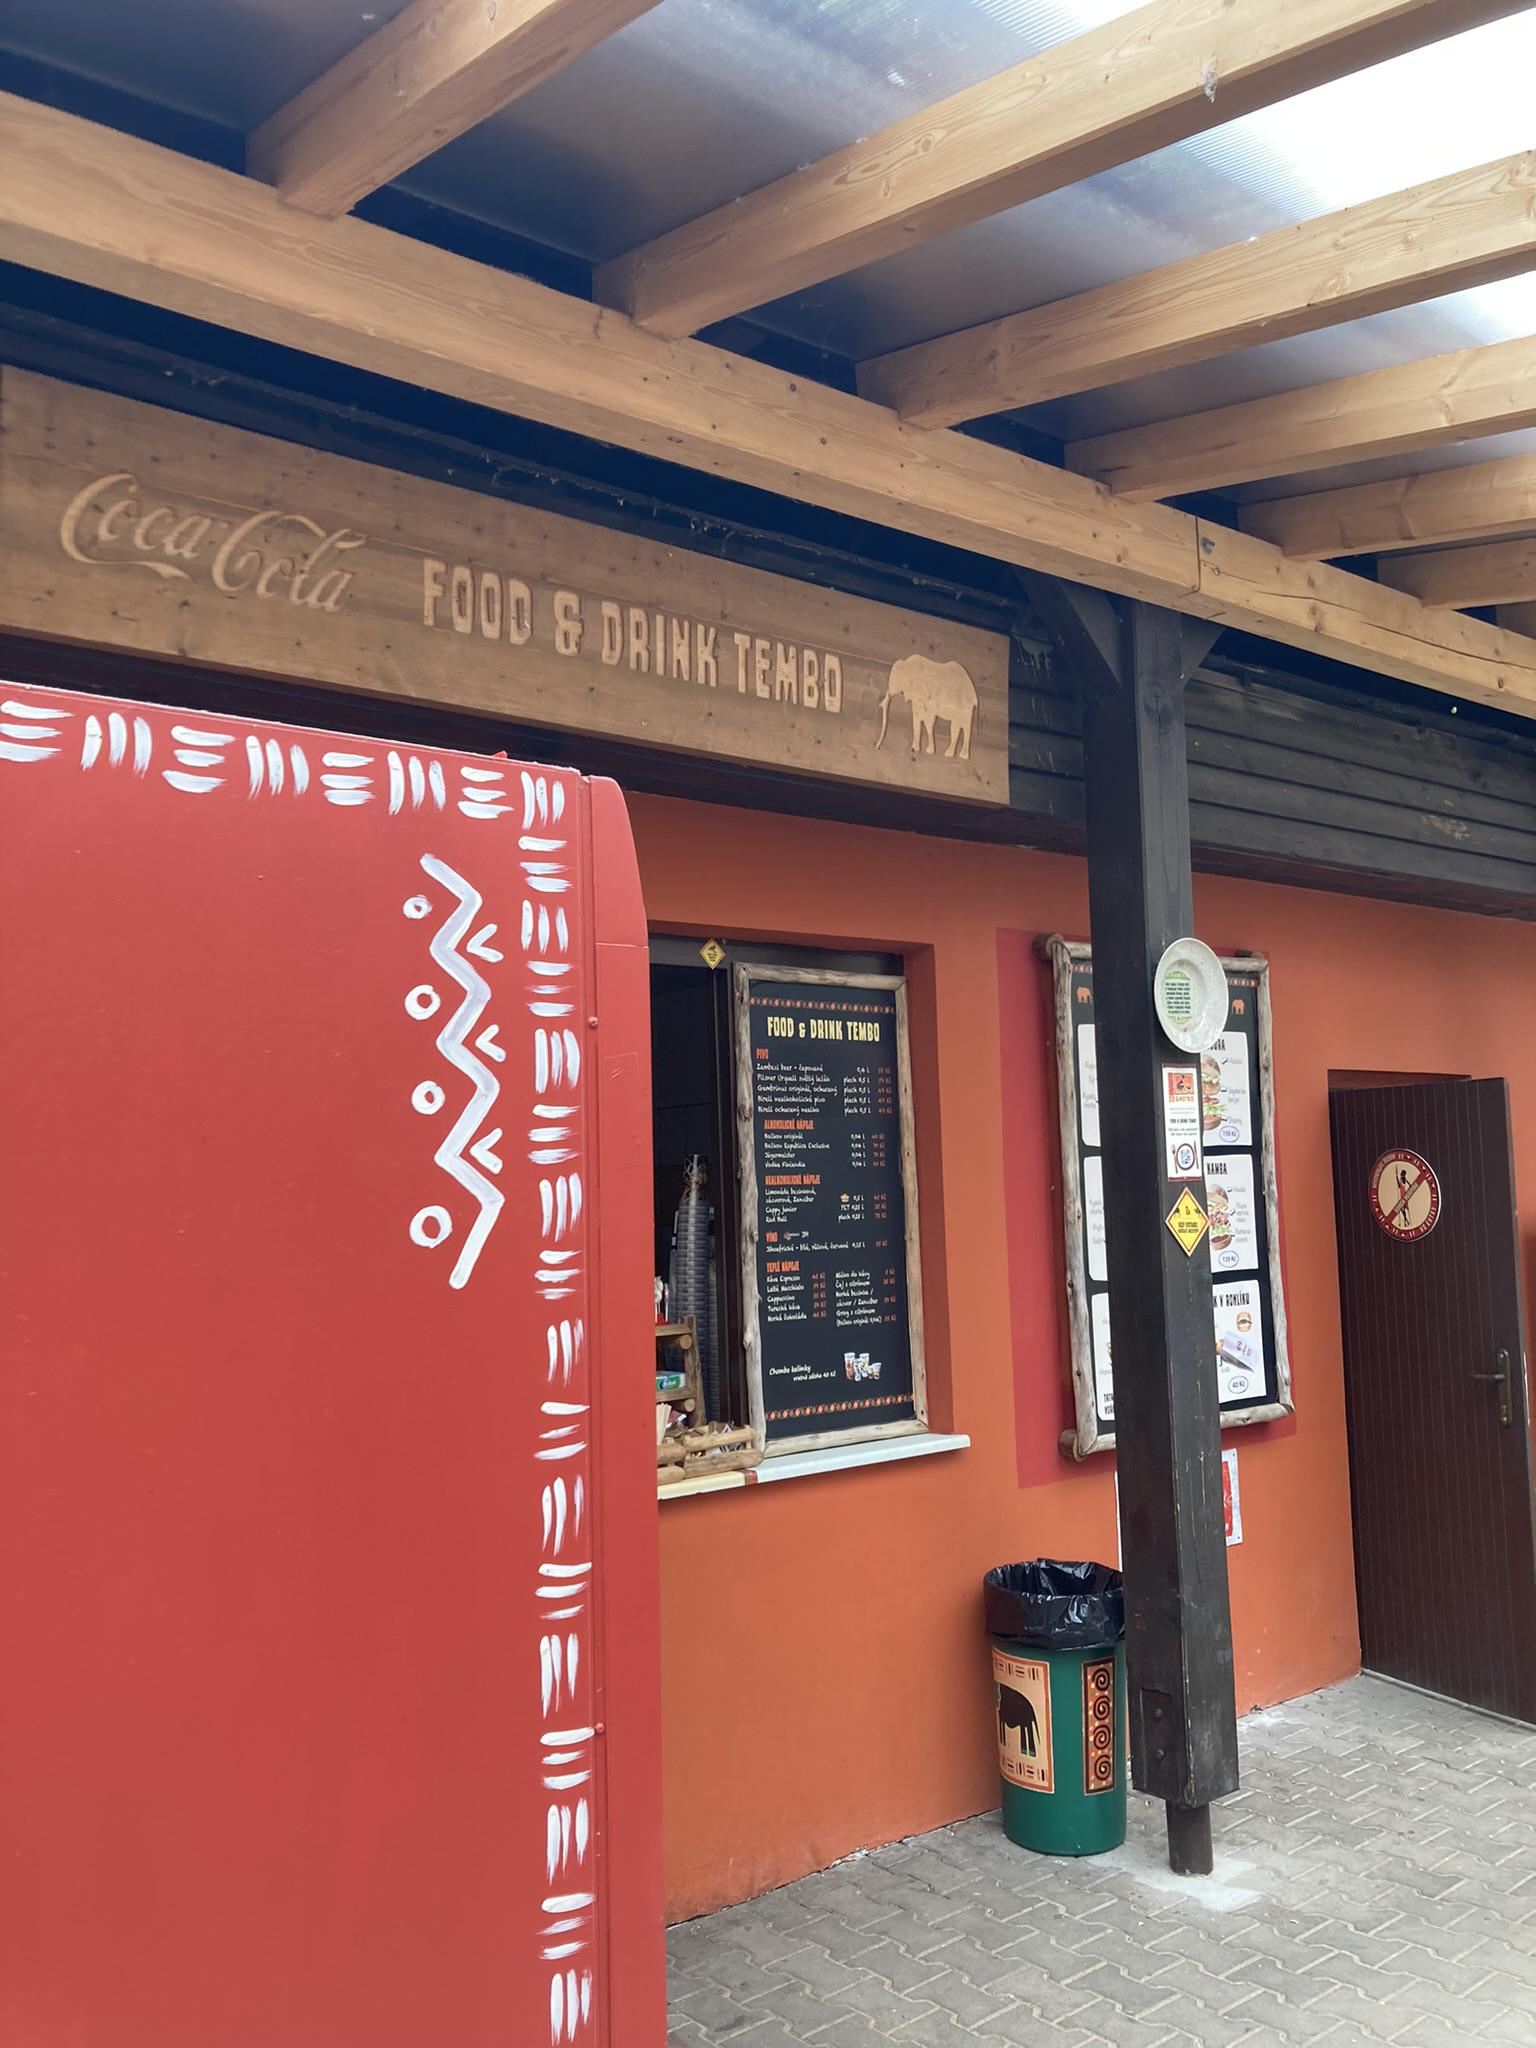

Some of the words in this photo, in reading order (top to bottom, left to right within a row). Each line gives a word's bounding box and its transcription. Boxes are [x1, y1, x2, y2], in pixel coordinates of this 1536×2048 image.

[424, 559, 532, 645] FOOD
[553, 591, 584, 656] &
[602, 601, 719, 687] DRINK
[734, 633, 843, 713] TEMBO
[767, 1016, 794, 1038] FOOD
[799, 1022, 806, 1038] &
[810, 1019, 843, 1040] DRINK
[847, 1021, 880, 1042] TEMBO
[1219, 1295, 1224, 1307] V
[1226, 1290, 1250, 1306] ROHLÍKU
